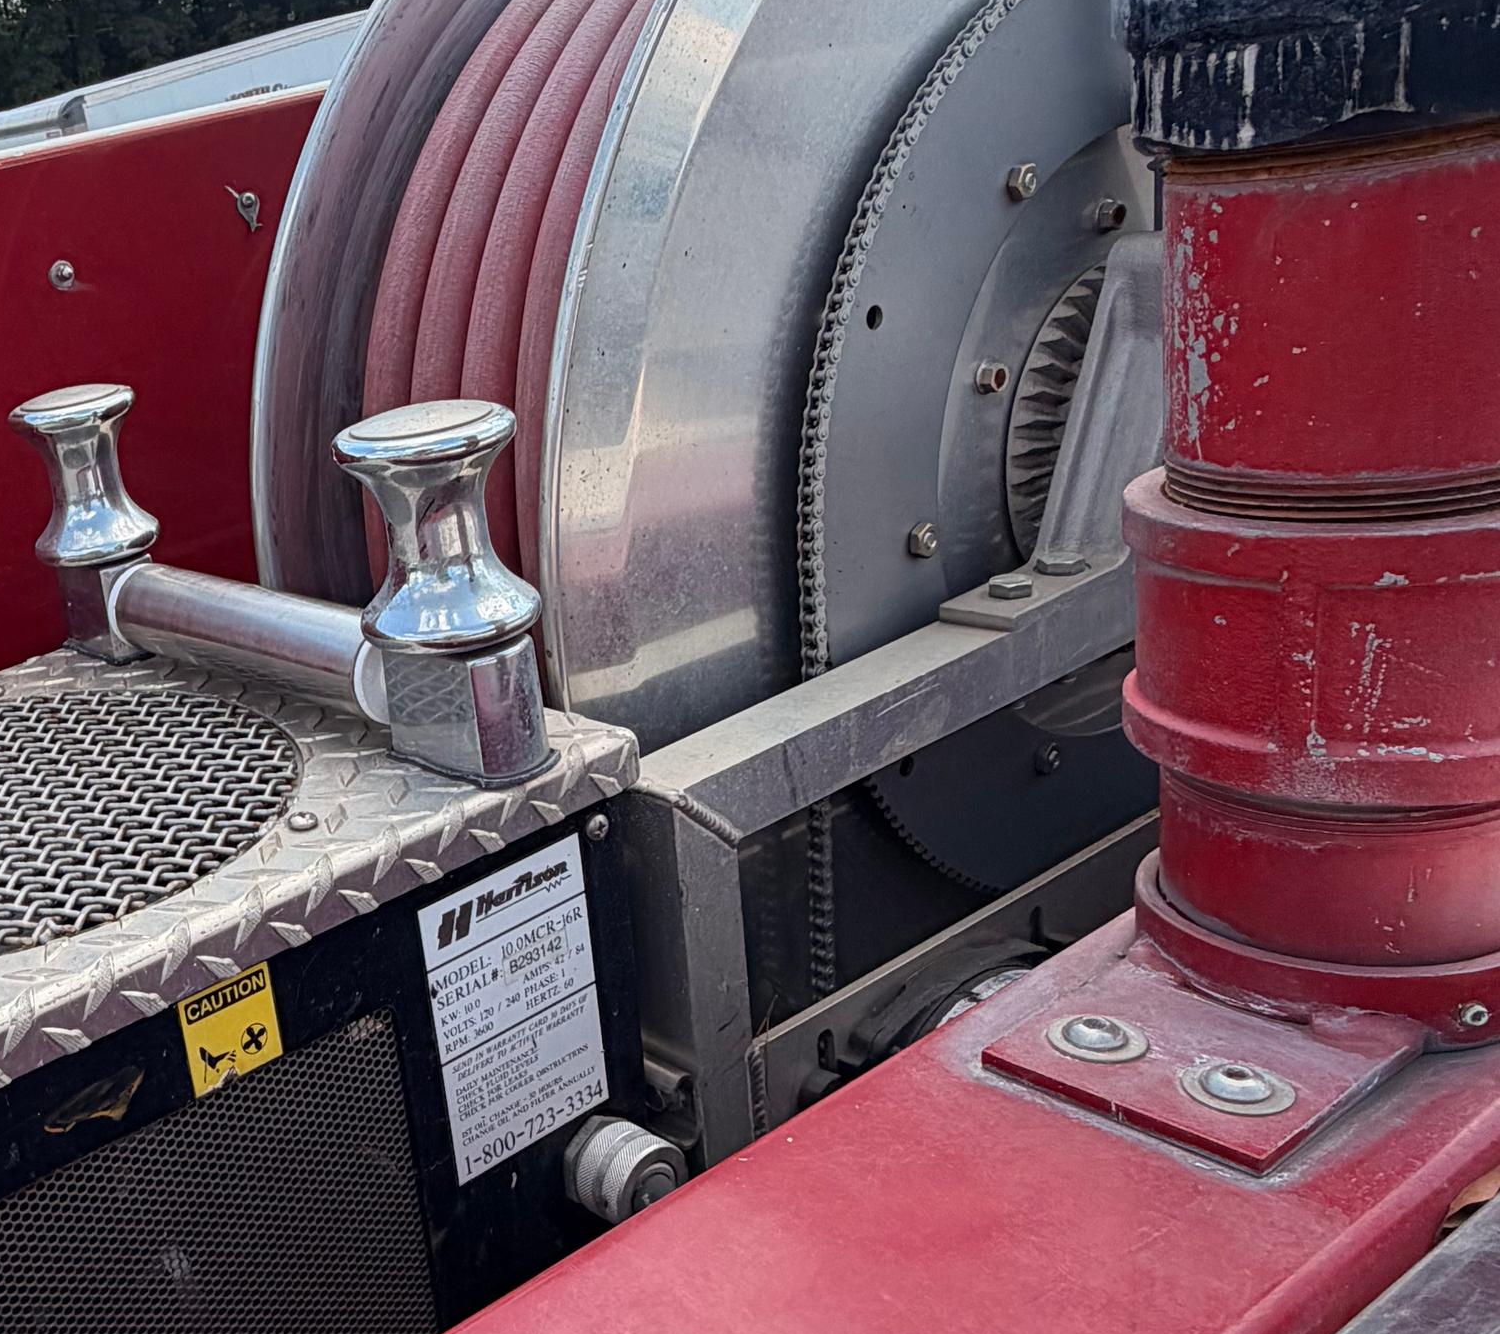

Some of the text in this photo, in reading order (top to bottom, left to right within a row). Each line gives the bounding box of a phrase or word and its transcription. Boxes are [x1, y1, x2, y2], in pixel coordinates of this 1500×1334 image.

[475, 860, 568, 917] Harrison
[434, 905, 583, 994] MODEL: 10.0MCR-16R
[436, 935, 562, 1011] SERIAL#: B293142
[522, 961, 551, 984] AMPS:
[574, 942, 584, 955] 84
[186, 972, 264, 1021] CAUTION
[523, 972, 558, 998] PHASE:
[525, 976, 574, 1010] HERTZ: 60
[440, 1009, 460, 1027] KW:
[442, 1016, 477, 1039] VOLTS:
[479, 1006, 494, 1022] 120
[504, 991, 520, 1007] 240
[444, 1020, 494, 1055] RPM: 3600
[485, 1026, 526, 1054] WARRANTY
[527, 1015, 548, 1031] CARD
[457, 1054, 494, 1082] DELIVERY
[545, 1004, 584, 1031] WARRANTY
[455, 1077, 478, 1097] DAILY
[456, 1053, 538, 1104] CHECK FLUID LEVELS
[457, 1068, 528, 1114] CHECK FOR LEAKS
[458, 1101, 486, 1121] CHECK
[487, 1091, 503, 1105] FOR
[504, 1073, 534, 1096] COOLER
[488, 1098, 521, 1122] CHANGE
[537, 1074, 563, 1094] HOURS
[462, 1122, 495, 1147] CHANGE
[512, 1103, 529, 1118] AND
[530, 1088, 556, 1108] FILTER
[557, 1065, 594, 1092] ANNUALLY
[464, 1078, 603, 1175] 1-800-723-3334
